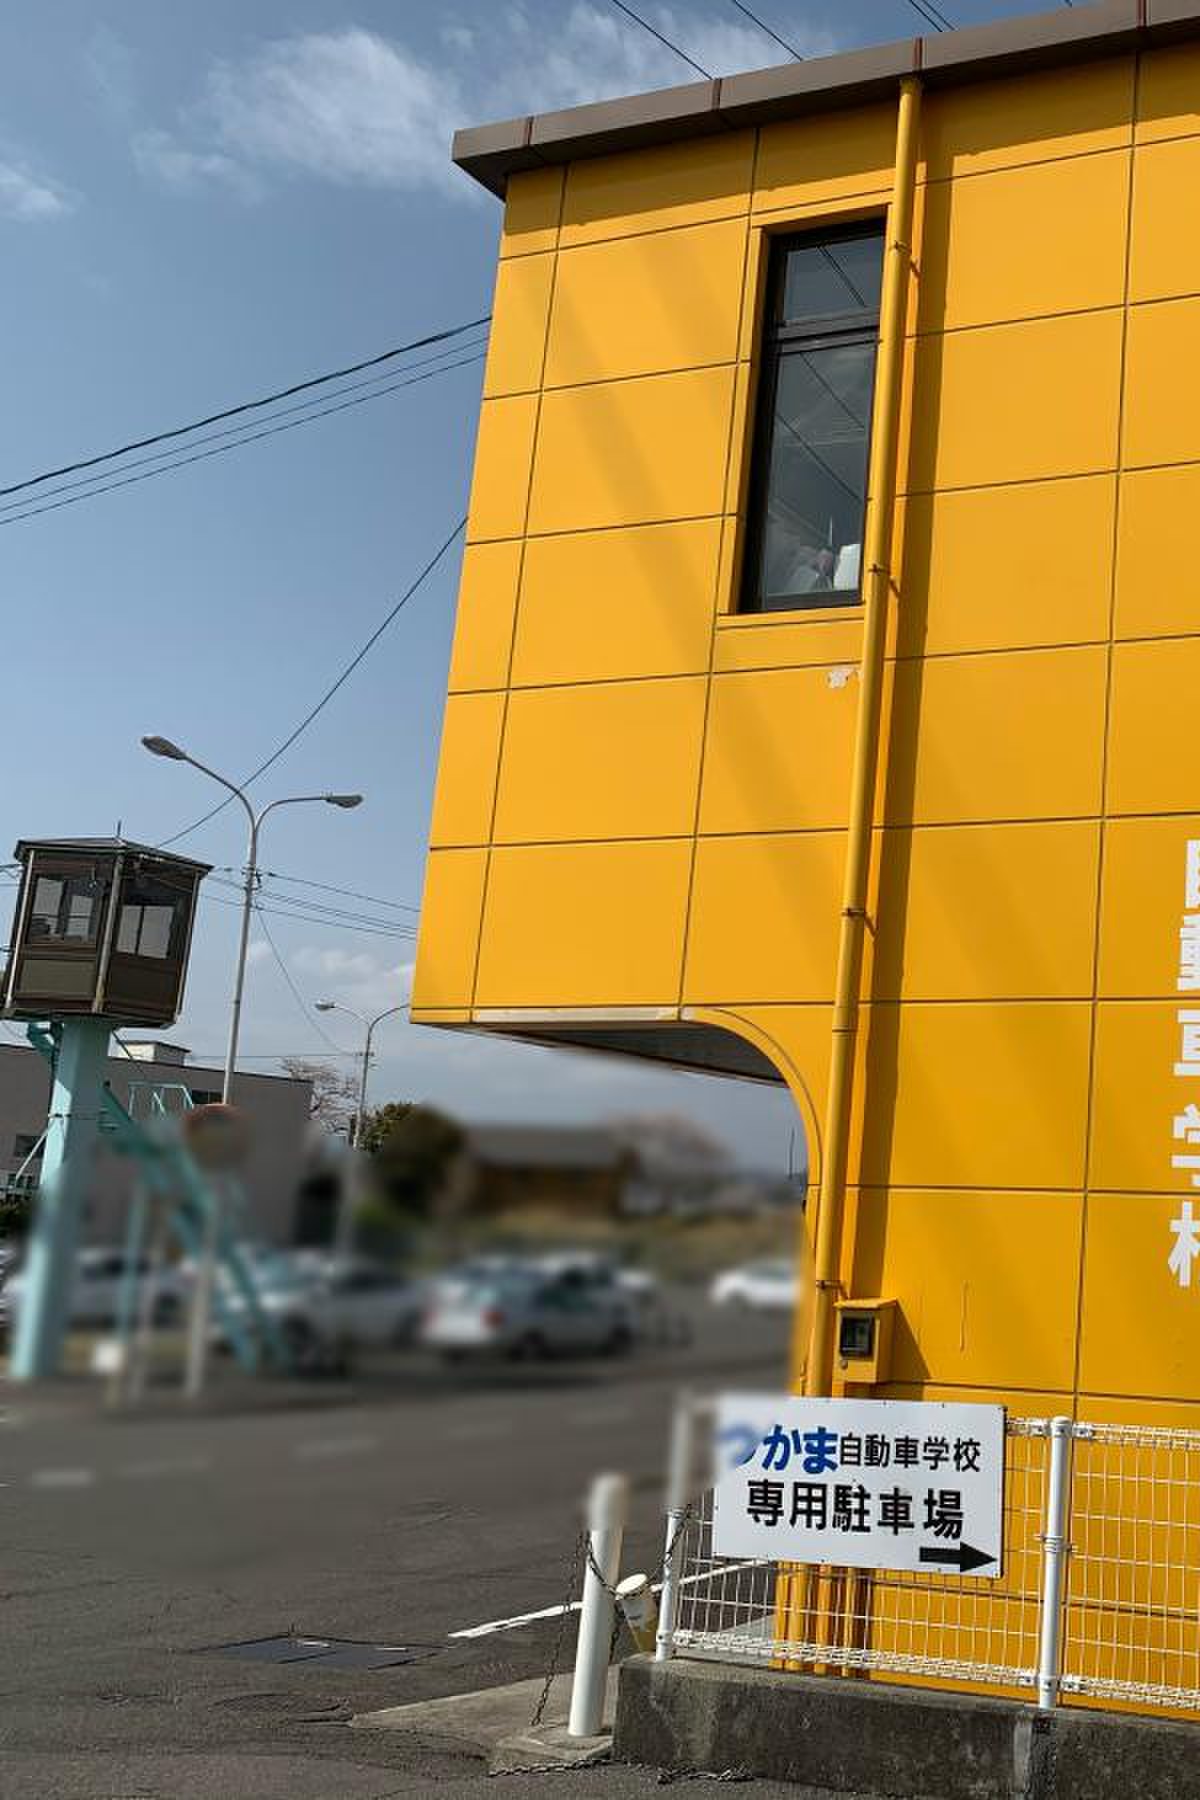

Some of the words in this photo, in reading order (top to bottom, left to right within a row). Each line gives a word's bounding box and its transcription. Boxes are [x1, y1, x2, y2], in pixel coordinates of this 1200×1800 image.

[746, 1479, 964, 1540] 専用駐車場
